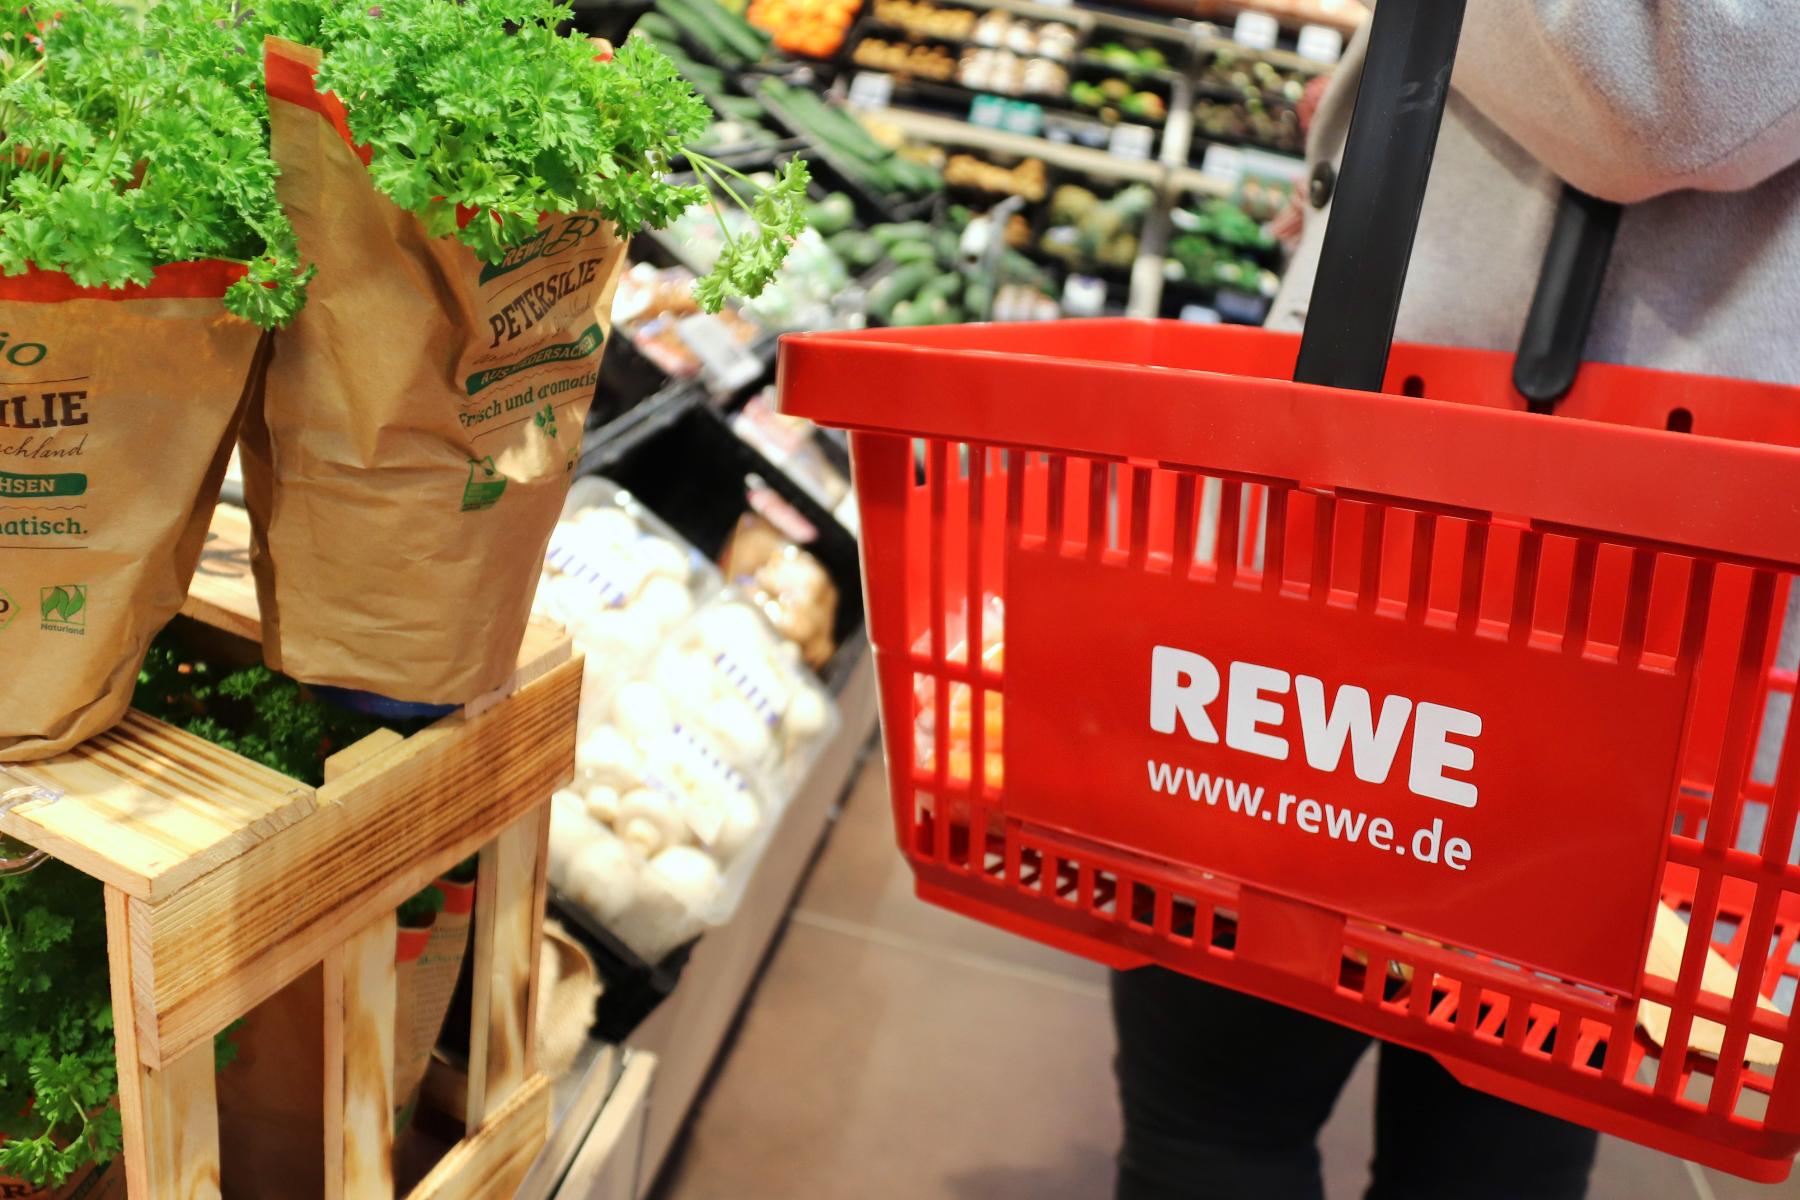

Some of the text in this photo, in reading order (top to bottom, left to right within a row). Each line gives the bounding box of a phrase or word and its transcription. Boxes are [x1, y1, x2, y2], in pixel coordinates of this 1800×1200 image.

[489, 257, 603, 348] PETERSILIE
[459, 400, 502, 427] Frisch
[506, 387, 534, 411] und
[0, 516, 88, 535] atisch.
[40, 623, 85, 637] Naturland
[1150, 645, 1482, 808] REWE
[1147, 759, 1472, 871] www.rewe.de
